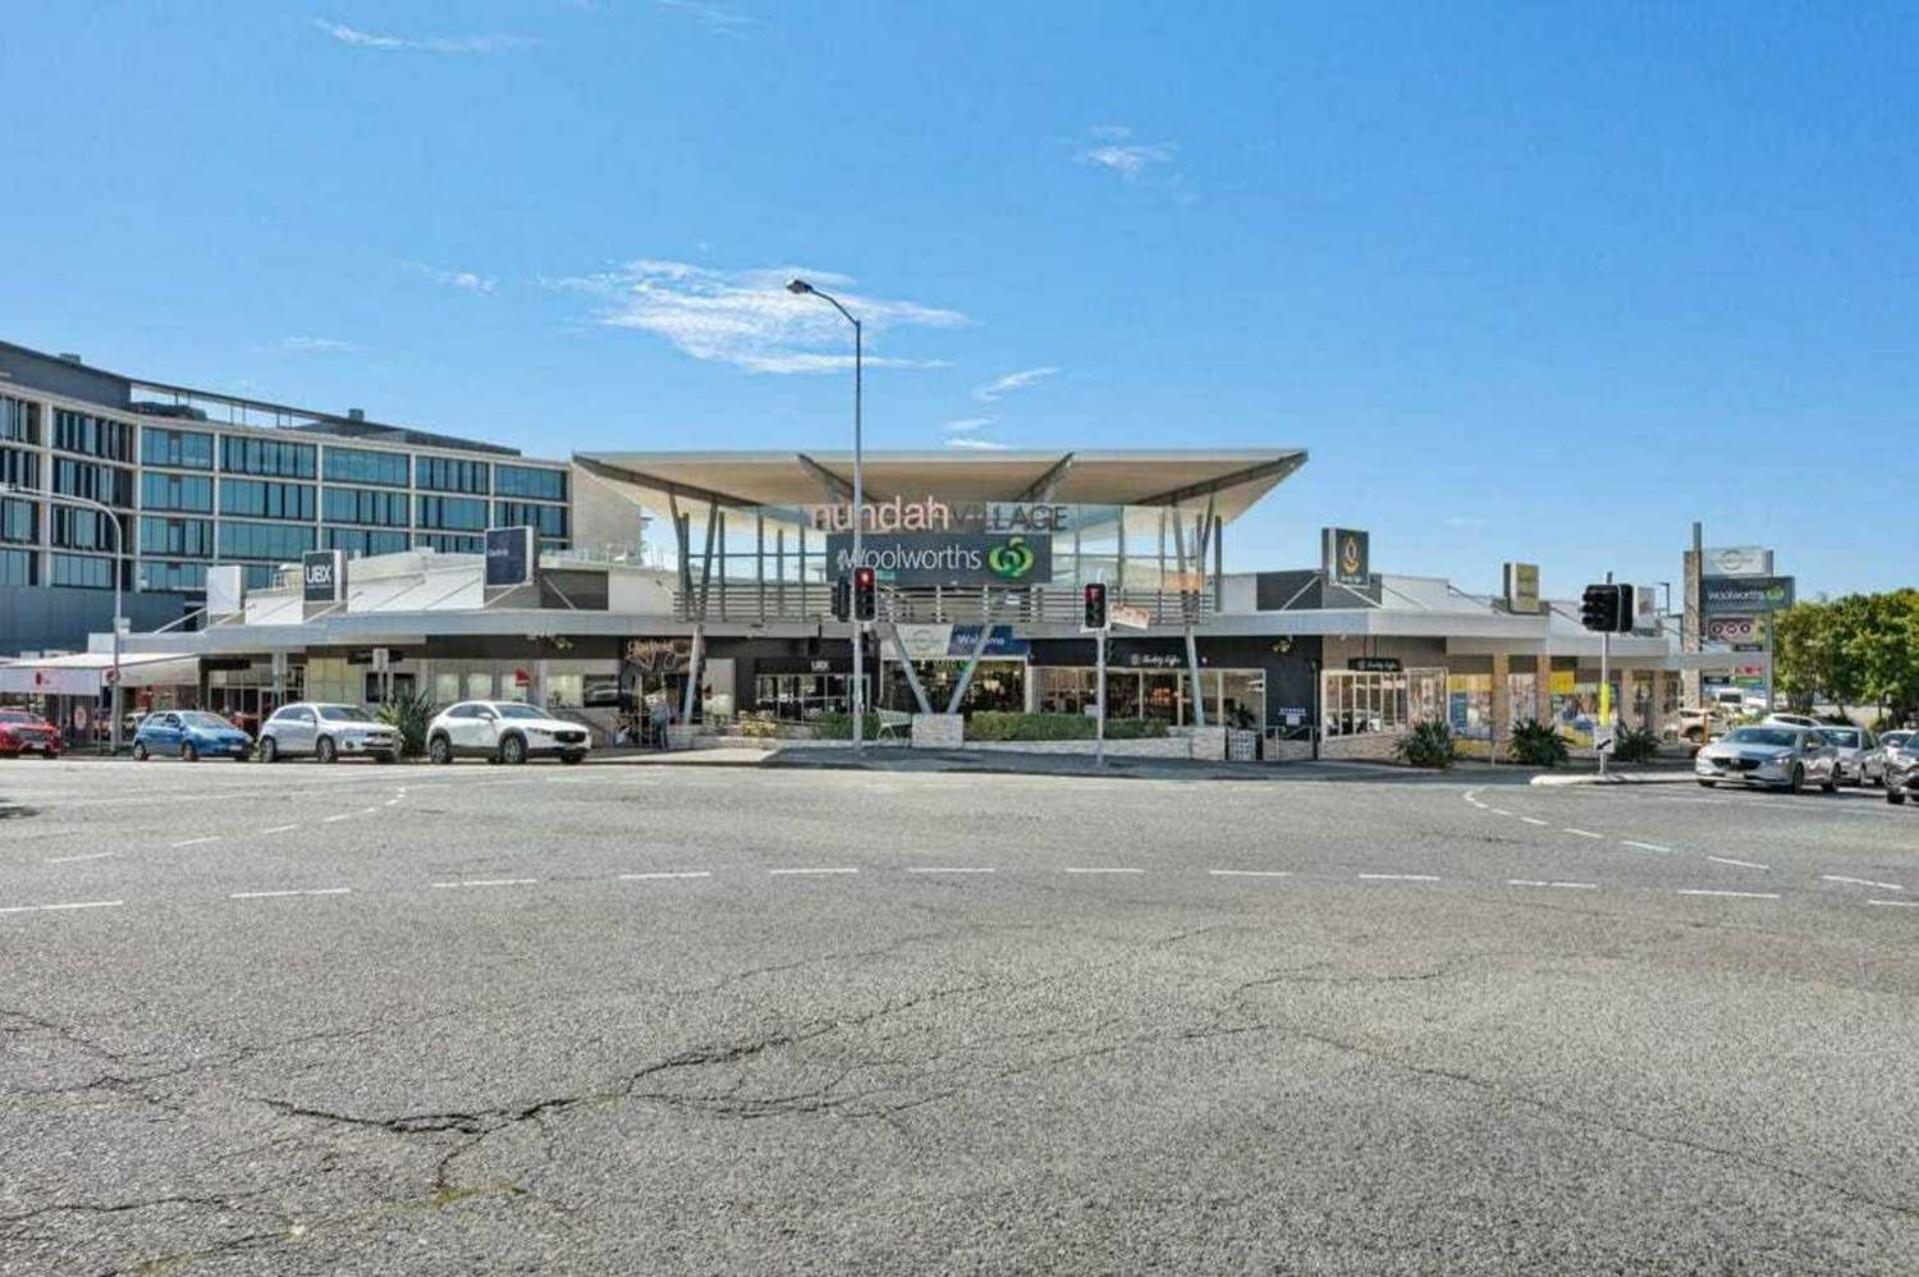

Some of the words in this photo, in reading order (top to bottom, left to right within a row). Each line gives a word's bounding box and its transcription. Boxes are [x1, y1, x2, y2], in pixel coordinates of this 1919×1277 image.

[810, 495, 950, 531] nundah
[840, 544, 982, 571] Woolworths
[306, 564, 332, 584] UBX
